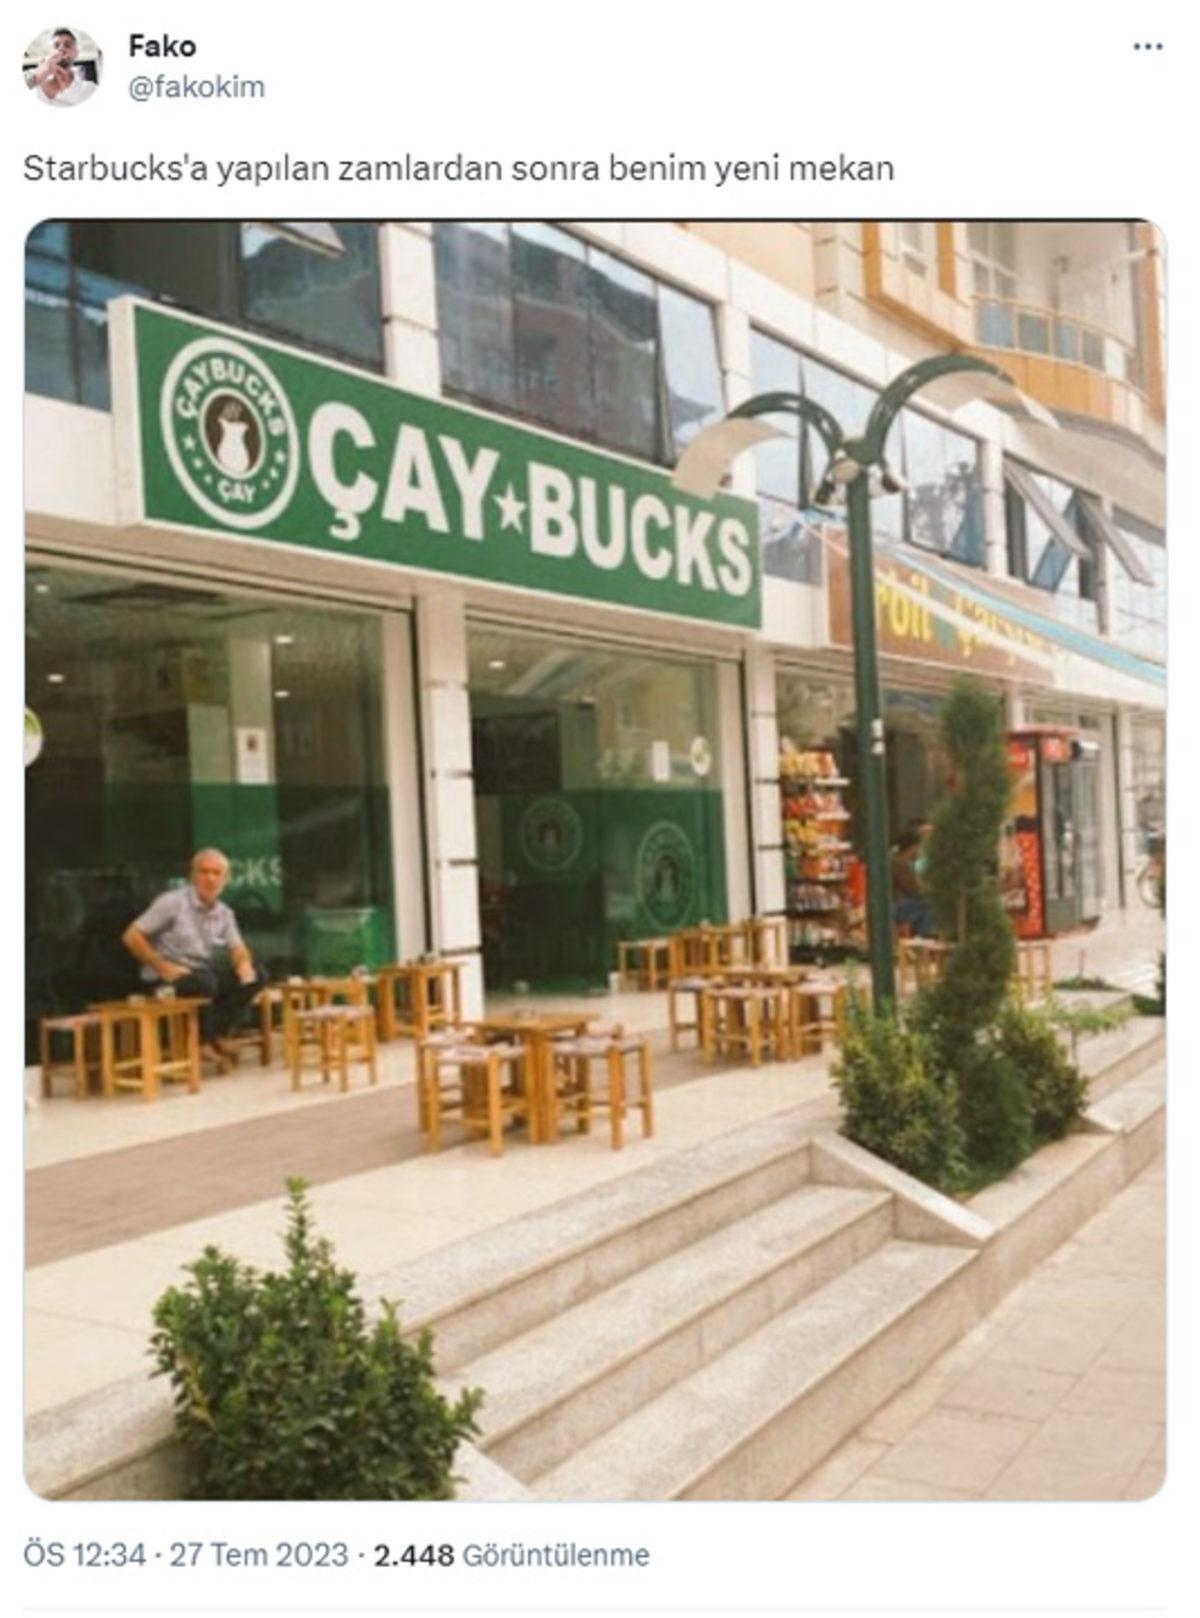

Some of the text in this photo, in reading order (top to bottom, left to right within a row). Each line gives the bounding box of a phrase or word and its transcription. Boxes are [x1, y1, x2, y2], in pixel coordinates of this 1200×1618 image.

[176, 357, 287, 437] ÇAYBUCKS
[216, 478, 256, 504] ÇAY
[307, 401, 752, 597] ÇAY BUCKS
